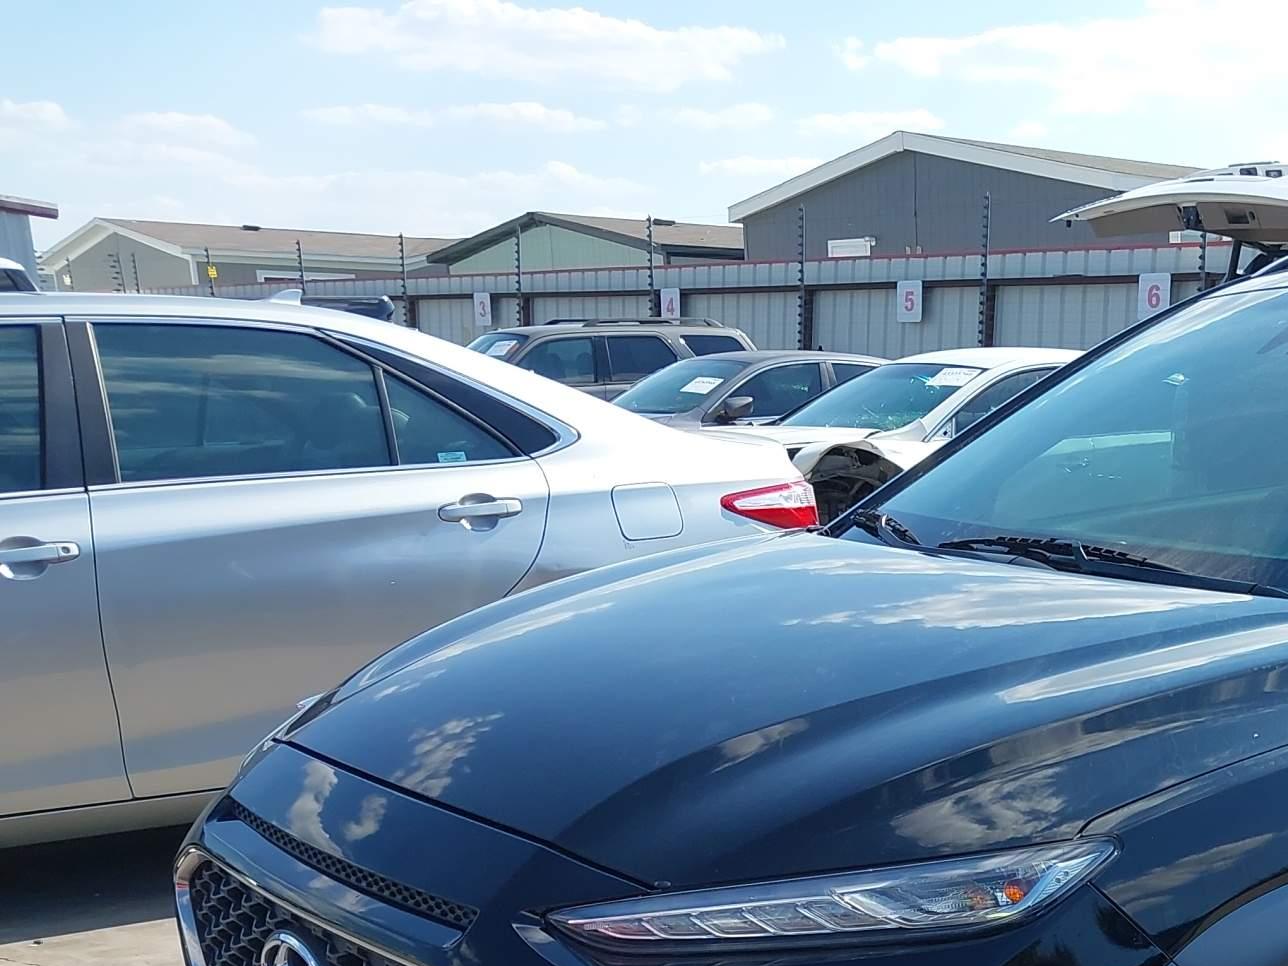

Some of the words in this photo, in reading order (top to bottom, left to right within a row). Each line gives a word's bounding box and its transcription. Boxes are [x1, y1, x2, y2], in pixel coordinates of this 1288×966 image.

[904, 291, 915, 312] 5
[1147, 284, 1161, 308] 6
[479, 301, 487, 317] 3
[666, 297, 675, 316] 4
